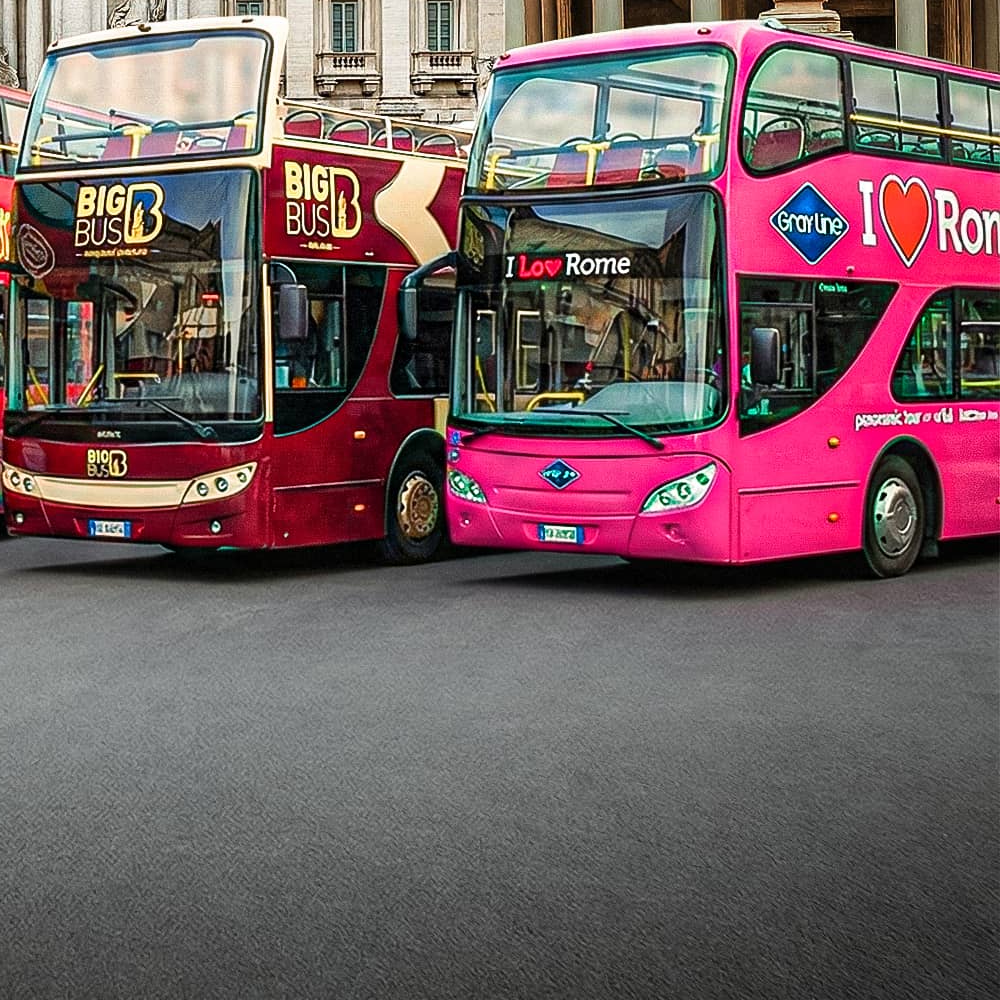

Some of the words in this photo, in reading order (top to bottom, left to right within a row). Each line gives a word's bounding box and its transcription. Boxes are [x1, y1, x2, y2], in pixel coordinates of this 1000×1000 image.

[284, 160, 329, 202] BIG
[76, 183, 126, 218] BIG
[858, 179, 878, 247] I
[74, 217, 122, 247] BUS
[286, 201, 330, 238] BUS
[505, 255, 515, 278] I
[565, 252, 631, 276] Rome
